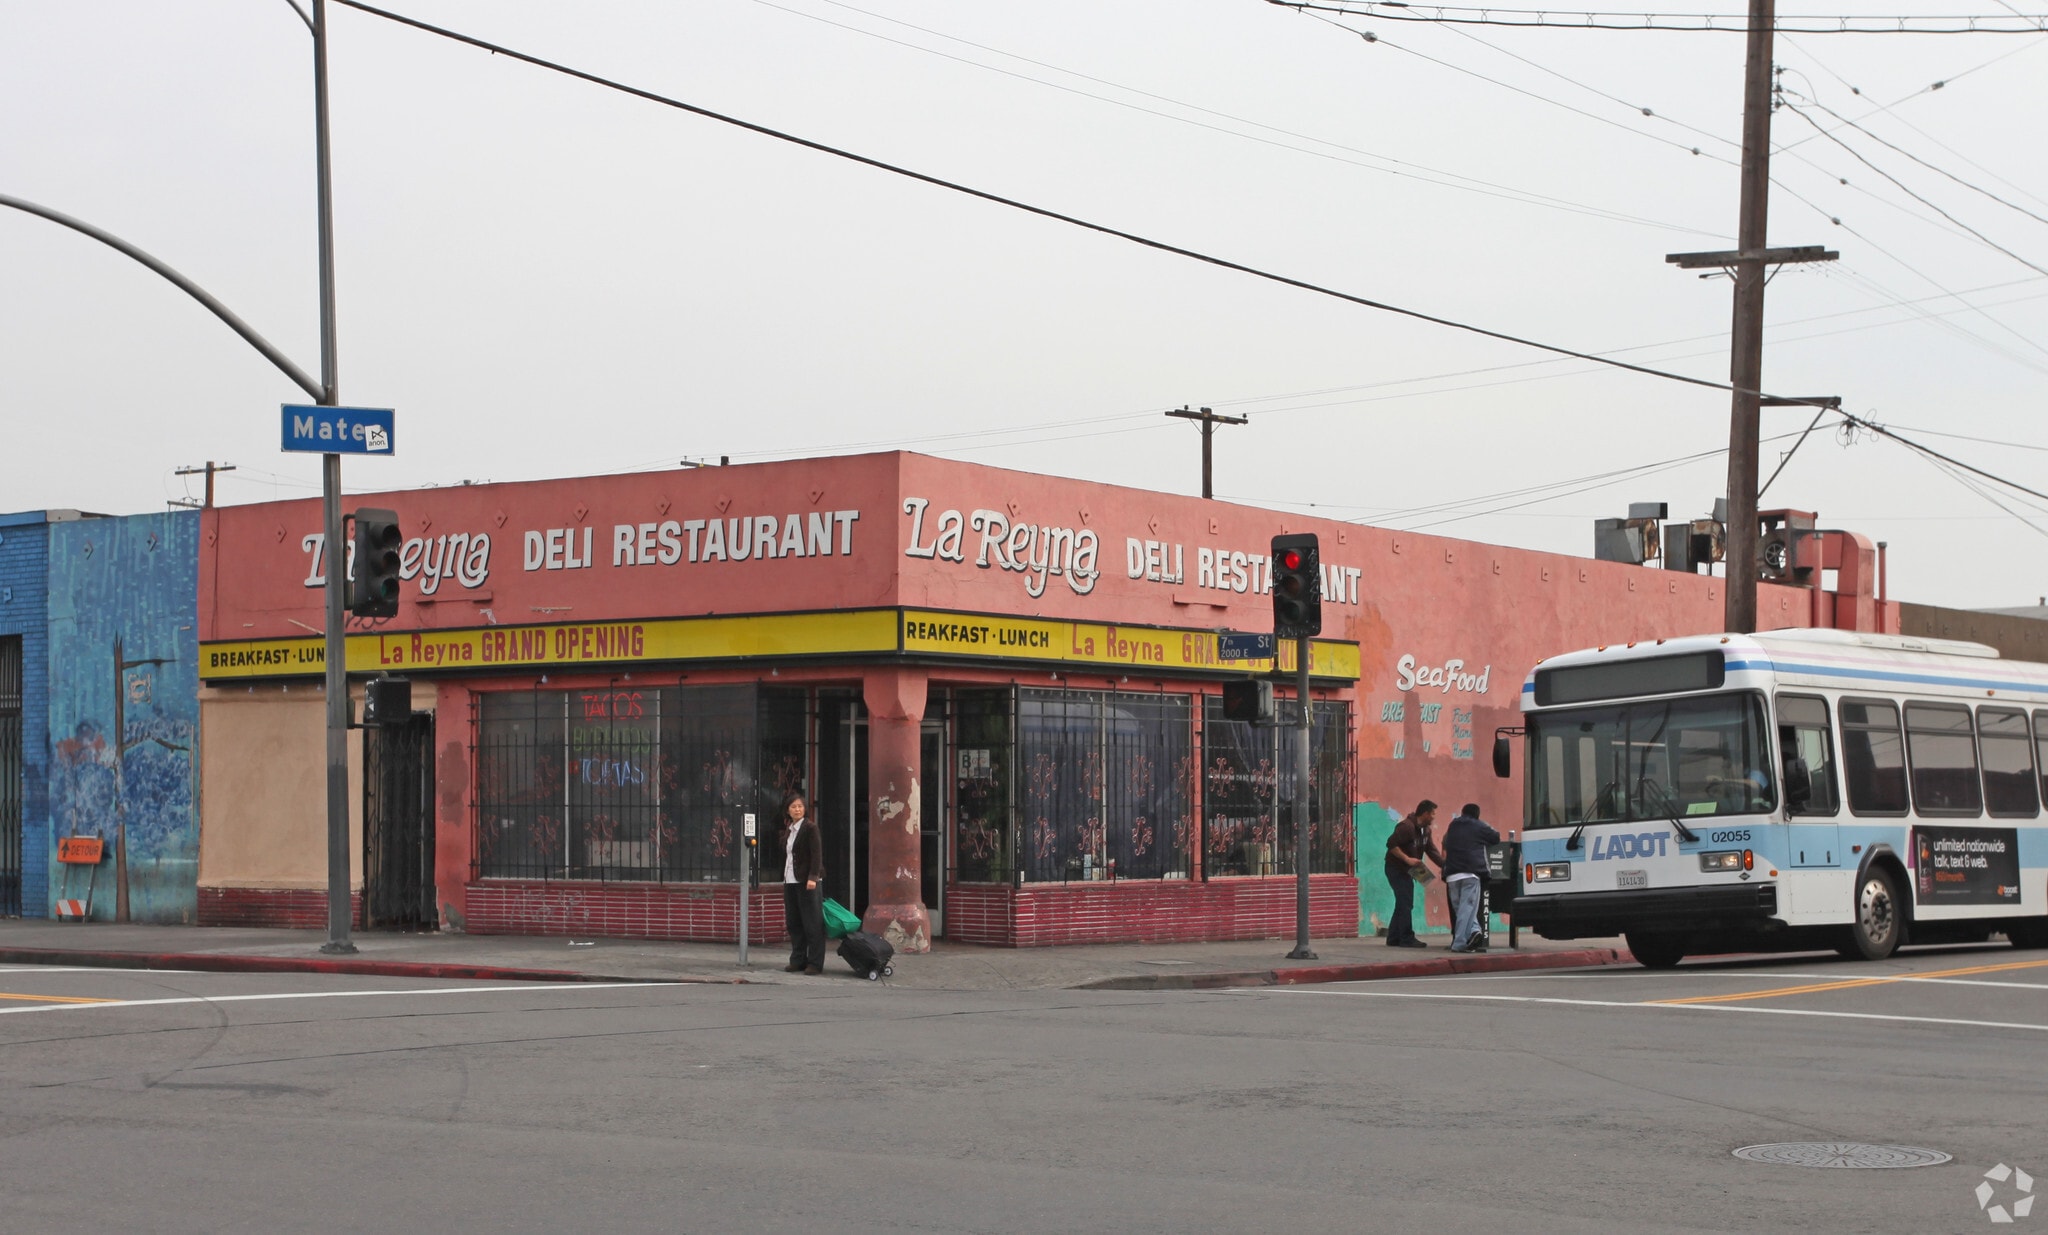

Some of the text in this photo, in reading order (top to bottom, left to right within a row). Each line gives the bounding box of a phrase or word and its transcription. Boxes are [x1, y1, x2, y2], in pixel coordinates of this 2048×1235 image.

[294, 415, 365, 440] Mate
[523, 510, 859, 571] DELI RESTAURANT
[903, 497, 1099, 597] La Reyna
[398, 532, 490, 595] eyna
[1126, 537, 1184, 584] DELI
[1198, 547, 1361, 604] RESTAANT
[380, 625, 643, 666] La Reyna GRAND OPENING
[906, 621, 1049, 647] REAKFAST LUNCH
[1072, 624, 1095, 656] La
[1107, 627, 1164, 662] Reyna
[1182, 633, 1236, 666] GRA
[1221, 635, 1270, 649] 7th St
[211, 647, 326, 667] BREAKFAST LUN
[1221, 649, 1248, 658] 2000 E
[1396, 653, 1491, 694] SeaFood
[581, 692, 644, 721] TACOS
[1381, 702, 1443, 724] BREAST
[962, 755, 971, 768] B
[1591, 831, 1671, 861] LADOT
[1711, 830, 1751, 843] 02055
[1933, 838, 2005, 853] unlimited nationwide
[71, 845, 99, 856] DETOUR
[1934, 854, 1949, 868] talk,
[1950, 855, 1964, 868] text
